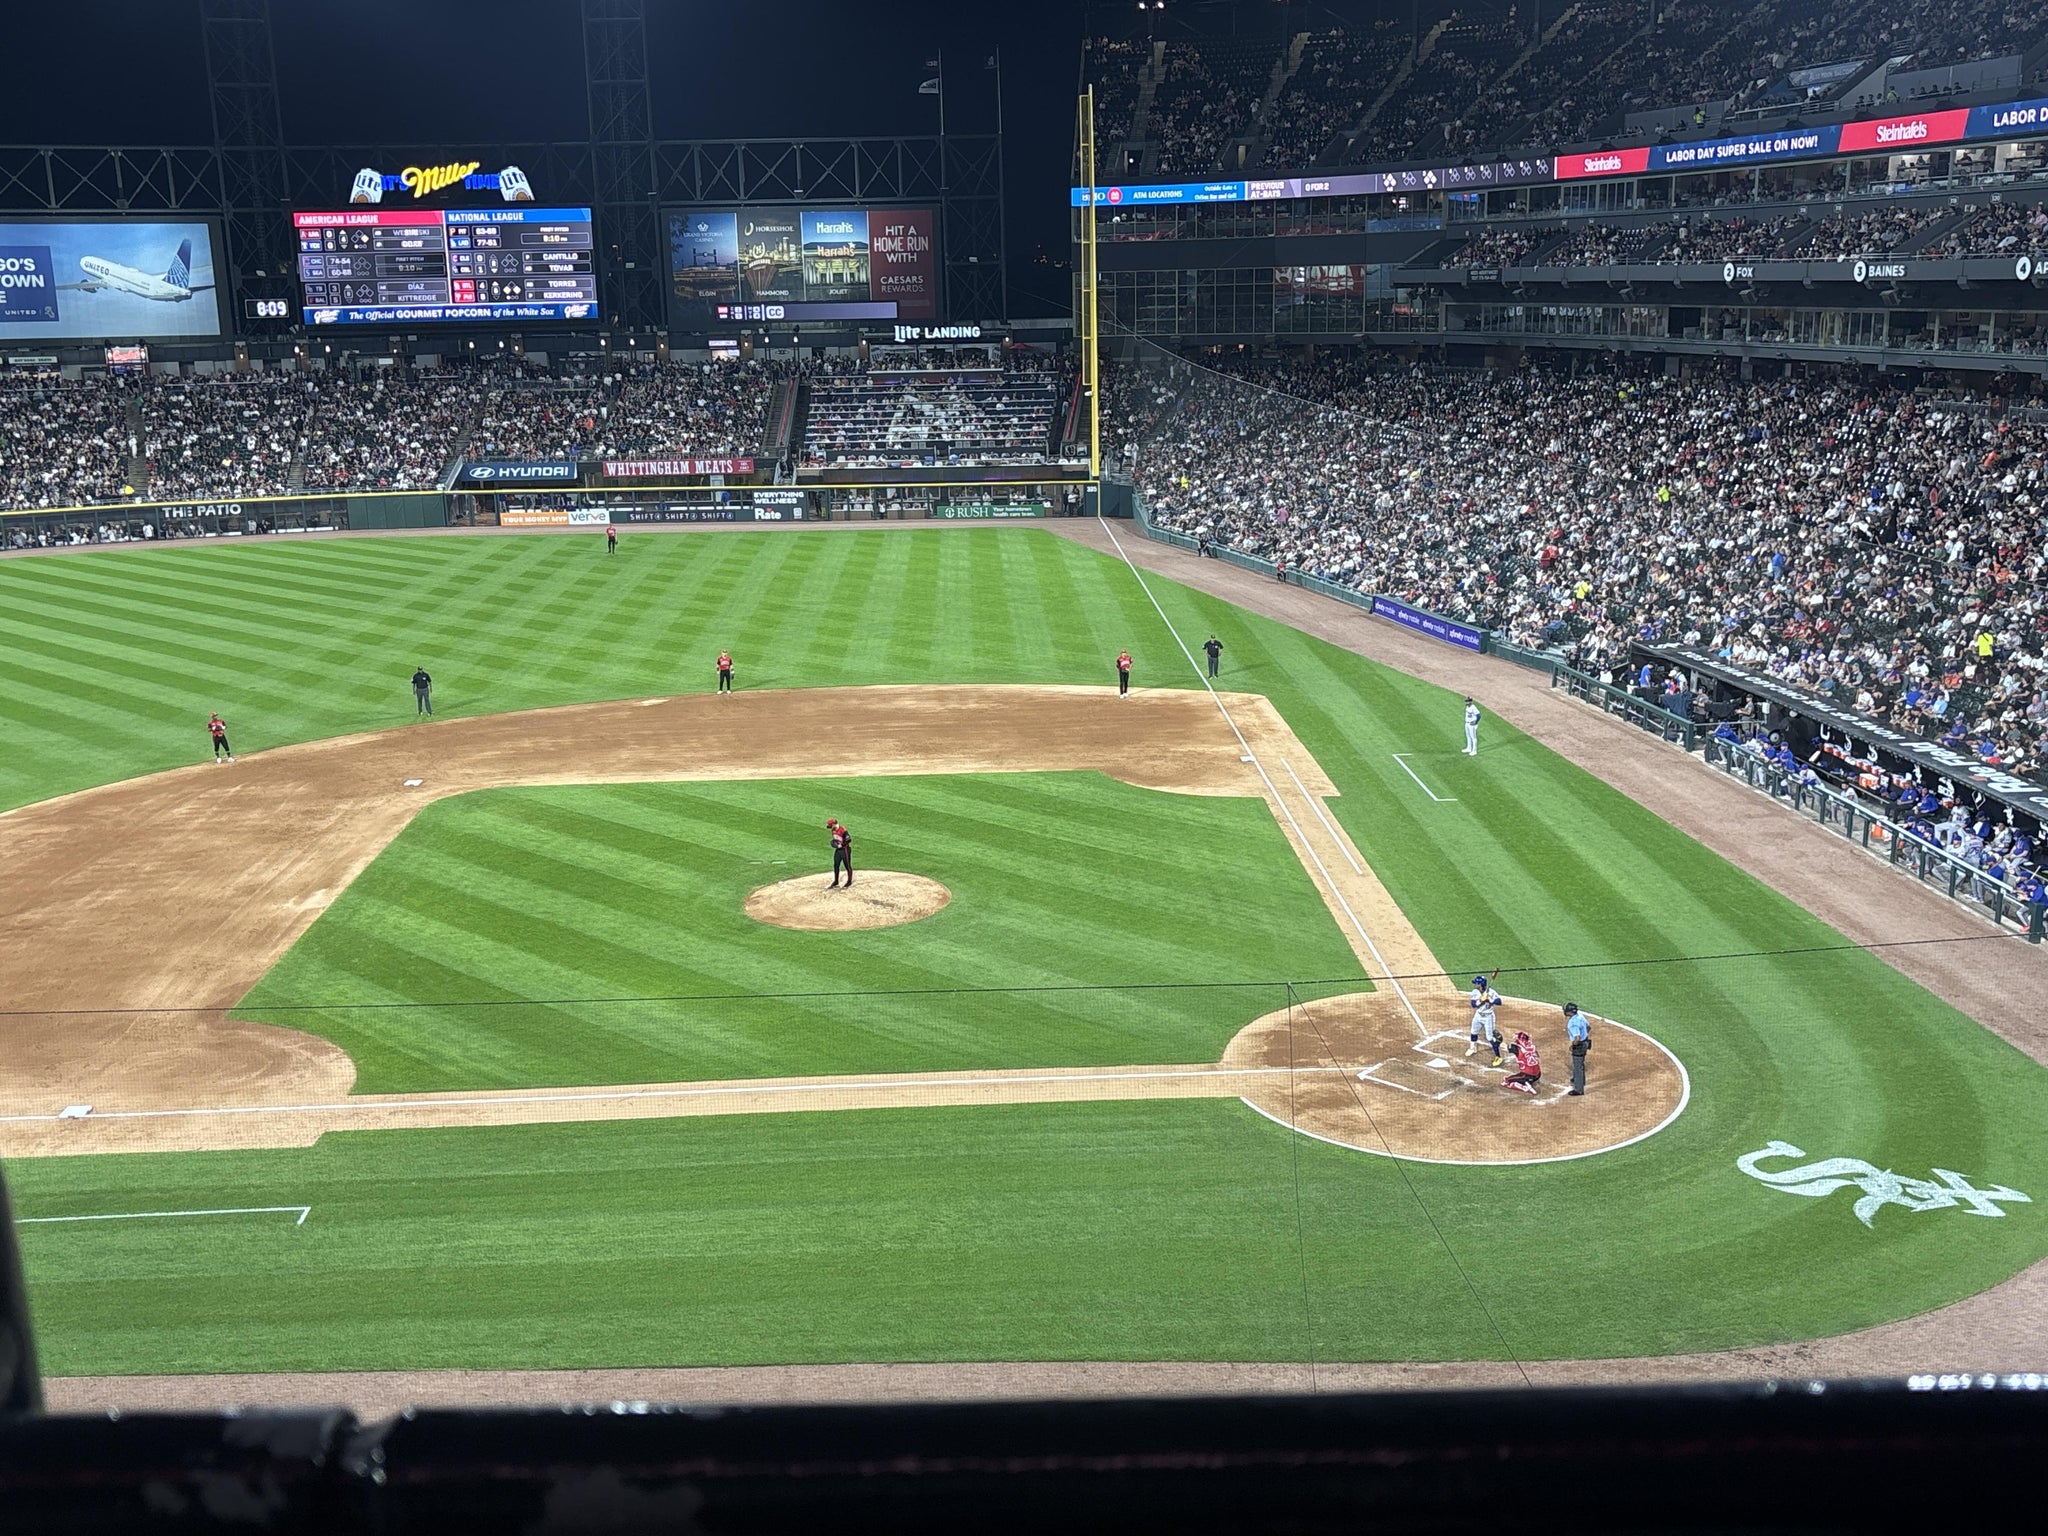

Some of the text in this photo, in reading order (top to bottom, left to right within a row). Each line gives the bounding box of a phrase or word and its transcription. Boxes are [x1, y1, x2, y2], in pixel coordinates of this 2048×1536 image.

[1993, 108, 2035, 126] LABOR
[1876, 121, 1927, 142] Steinhafels
[1666, 135, 1819, 162] LABOR DAY SUPER SALE ON NOW!
[1583, 157, 1621, 172] Steinhafels
[357, 174, 380, 191] Lite
[401, 161, 480, 198] Miller
[501, 172, 526, 191] Lite
[1251, 182, 1284, 190] PREVIOUS
[1133, 190, 1182, 199] ATM LOCATIONS
[298, 215, 379, 224] AMERICAN LEAGUE
[448, 212, 524, 221] NATIONAL LEAGUE
[816, 222, 853, 234] Harrah's
[885, 225, 917, 235] HIT A
[874, 236, 929, 252] HOME RUN
[817, 245, 855, 257] Harrah's
[886, 252, 918, 263] WITH
[84, 261, 110, 276] UNITED
[1736, 266, 1754, 278] FOX
[1868, 265, 1905, 277] BAINES
[0, 275, 45, 288] OWN
[880, 276, 923, 284] CAESARS
[256, 301, 287, 317] 8:09
[366, 310, 394, 320] Official
[396, 309, 442, 318] GOURMET
[446, 308, 491, 317] POPCORN
[493, 308, 502, 318] of
[503, 308, 515, 316] the
[517, 308, 539, 316] White
[768, 308, 782, 316] CC
[894, 325, 981, 342] Lite LANDING
[499, 466, 568, 477] HYUNDAI
[606, 459, 733, 476] WHITTINGHAM MEATS
[162, 504, 241, 518] THE PATIO
[571, 511, 606, 522] verve
[754, 507, 781, 519] Rate
[957, 508, 988, 518] RUSH
[1449, 629, 1480, 645] xfinity mobile
[1899, 741, 1981, 767] Field
